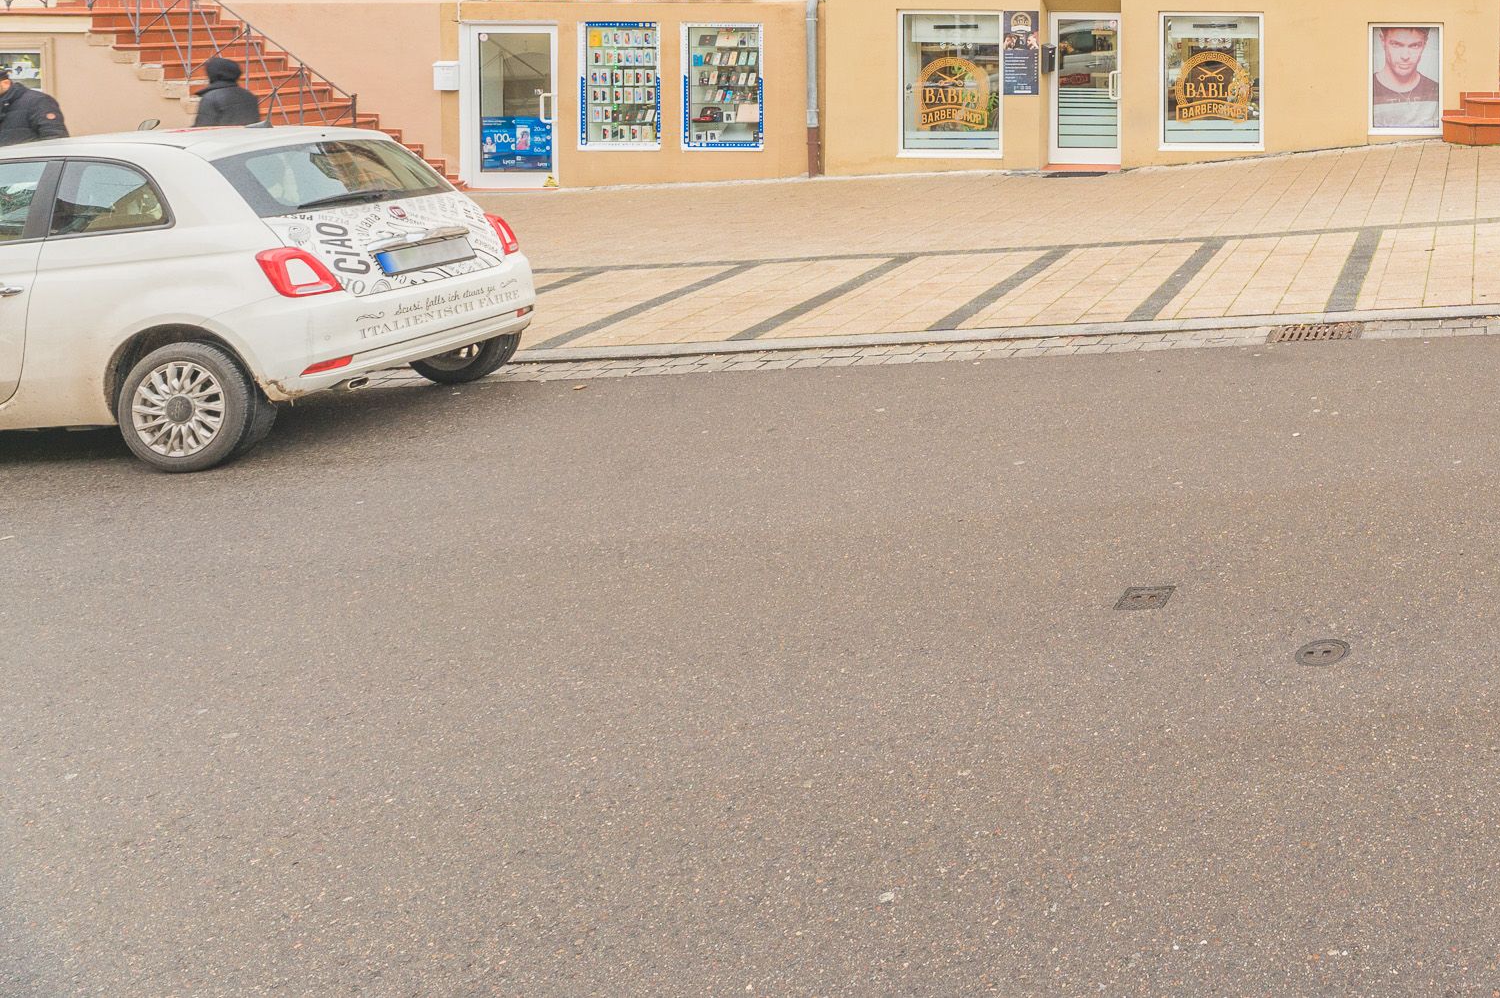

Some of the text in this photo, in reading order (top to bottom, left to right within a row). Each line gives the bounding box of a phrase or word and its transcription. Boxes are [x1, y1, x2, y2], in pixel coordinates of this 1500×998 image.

[924, 87, 979, 104] BABLO
[1185, 82, 1239, 99] BABLO
[921, 108, 982, 124] BARBERSHOP
[1182, 103, 1242, 119] BARBERSHOP
[425, 295, 446, 310] falls
[447, 290, 460, 302] ich
[462, 286, 485, 299] etwas
[358, 289, 521, 340] ITALIENISCH FAHRE
